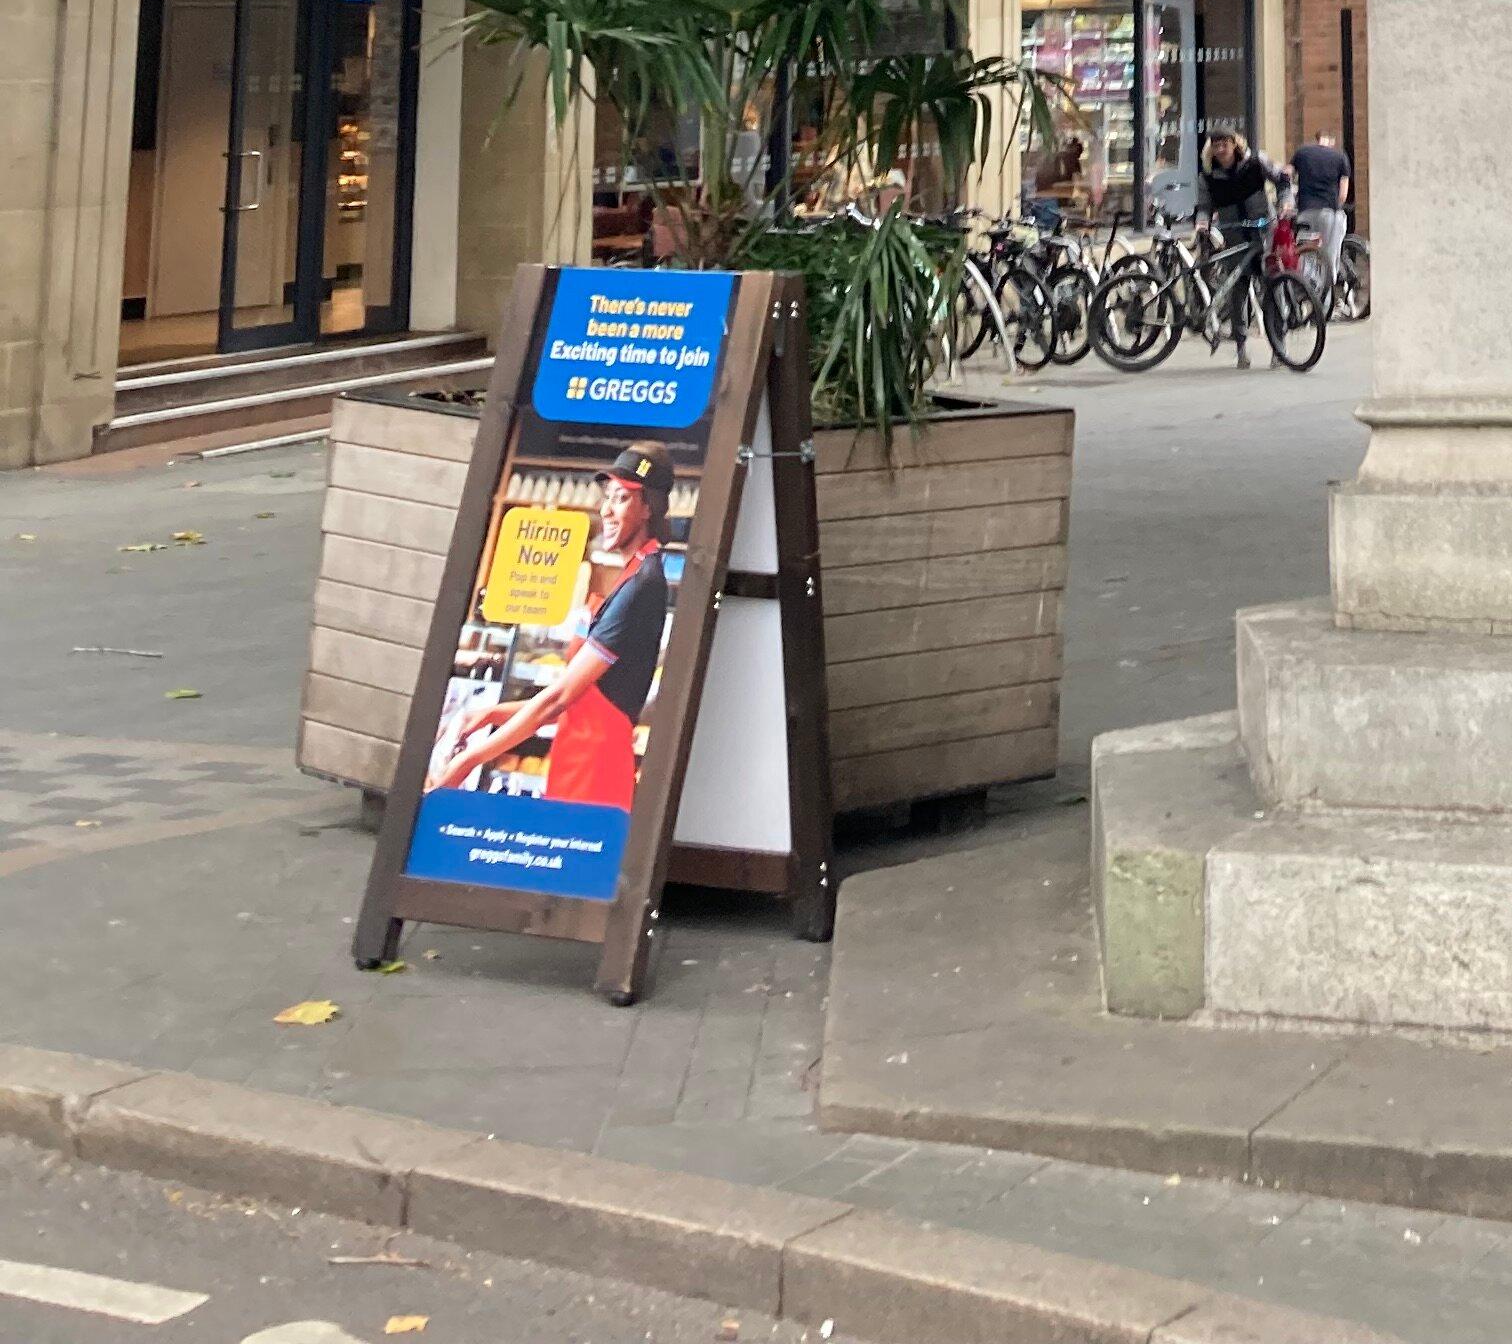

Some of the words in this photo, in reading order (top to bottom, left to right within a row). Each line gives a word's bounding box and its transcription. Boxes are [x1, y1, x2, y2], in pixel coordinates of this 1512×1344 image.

[590, 294, 645, 316] There's
[647, 301, 693, 317] never
[586, 318, 628, 337] been
[629, 325, 640, 338] a
[642, 324, 685, 340] more
[550, 340, 618, 366] Exciting
[620, 343, 657, 365] time
[659, 346, 677, 365] to
[675, 345, 710, 370] join
[589, 378, 678, 405] GREGGS
[516, 519, 571, 547] Hiring
[516, 545, 559, 566] Now
[509, 571, 527, 584] Pop
[483, 828, 508, 843] Apply
